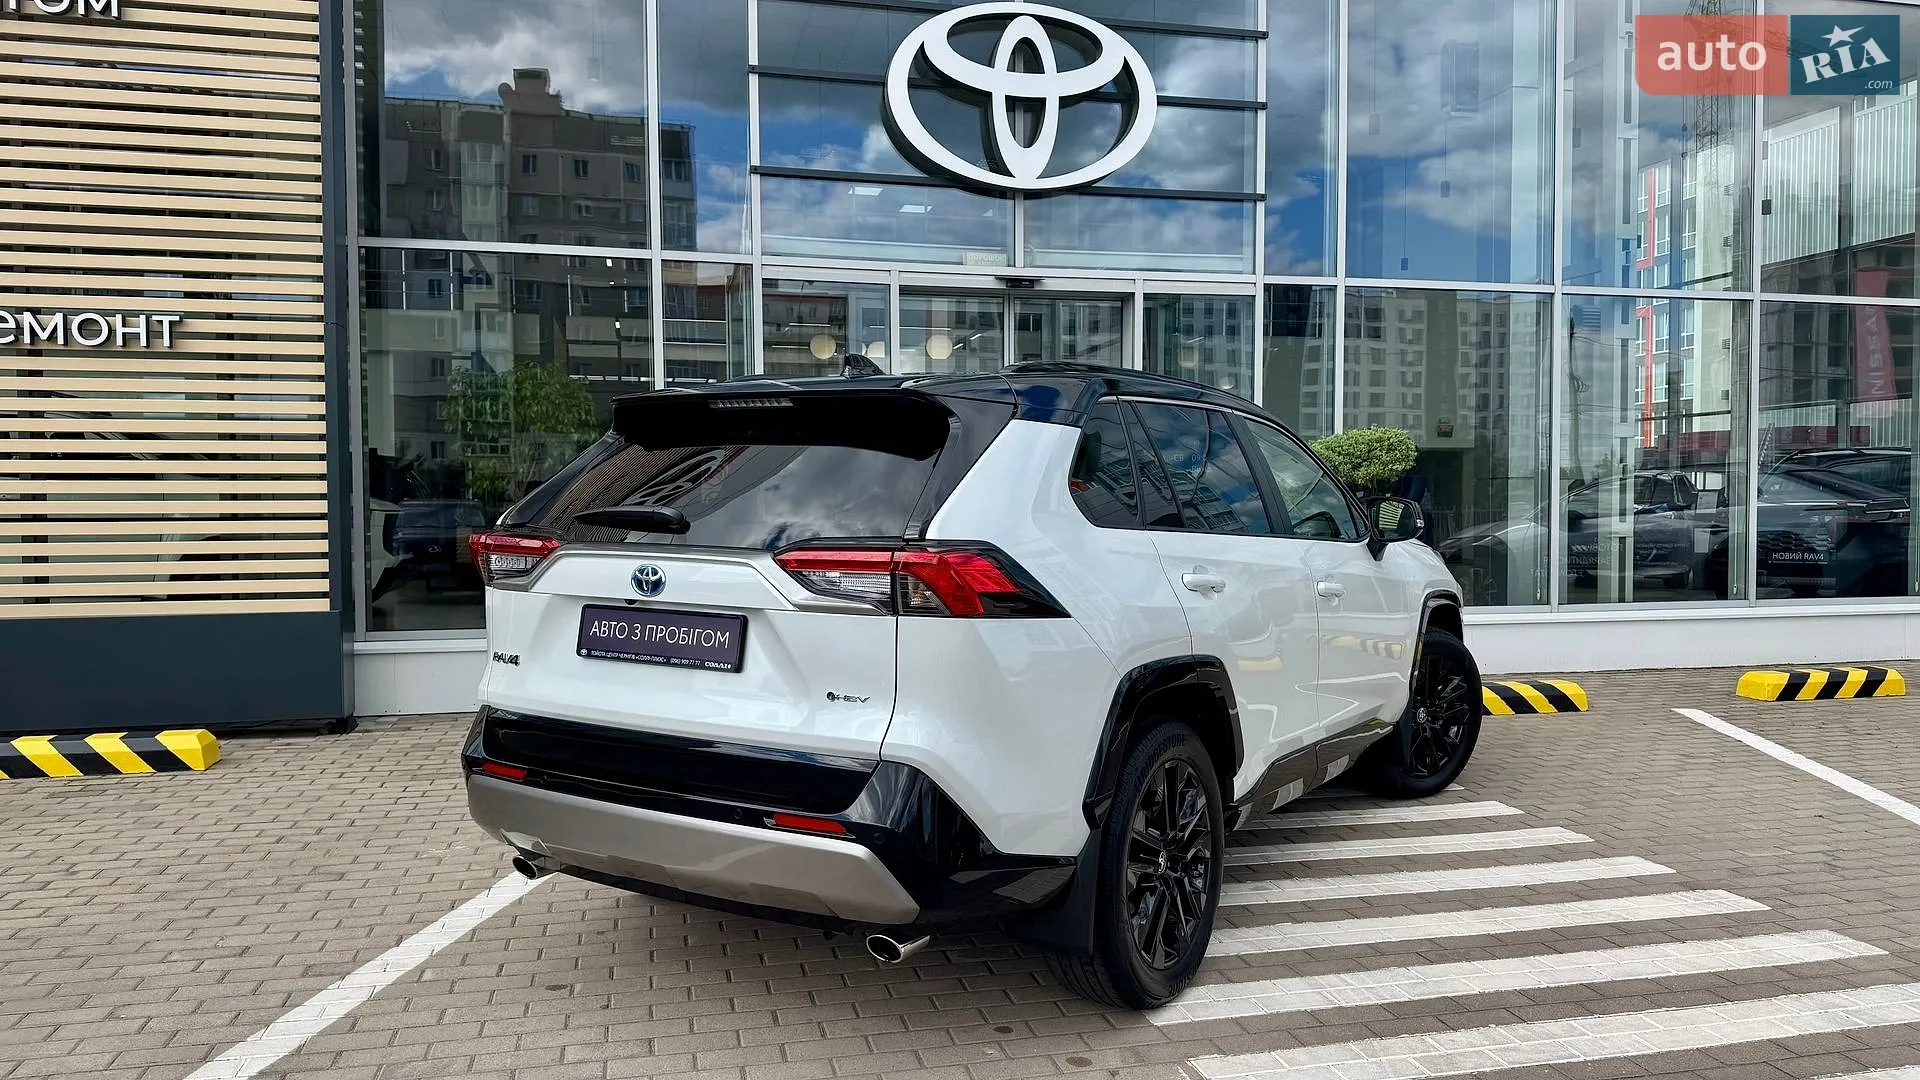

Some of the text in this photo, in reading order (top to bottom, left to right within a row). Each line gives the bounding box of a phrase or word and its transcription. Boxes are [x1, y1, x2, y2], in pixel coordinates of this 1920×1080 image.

[1772, 551, 1824, 560] НОВИЙ RAV4
[589, 620, 628, 639] АВТО
[644, 624, 730, 648] ПРОБІГОМ
[493, 651, 520, 666] RAV4
